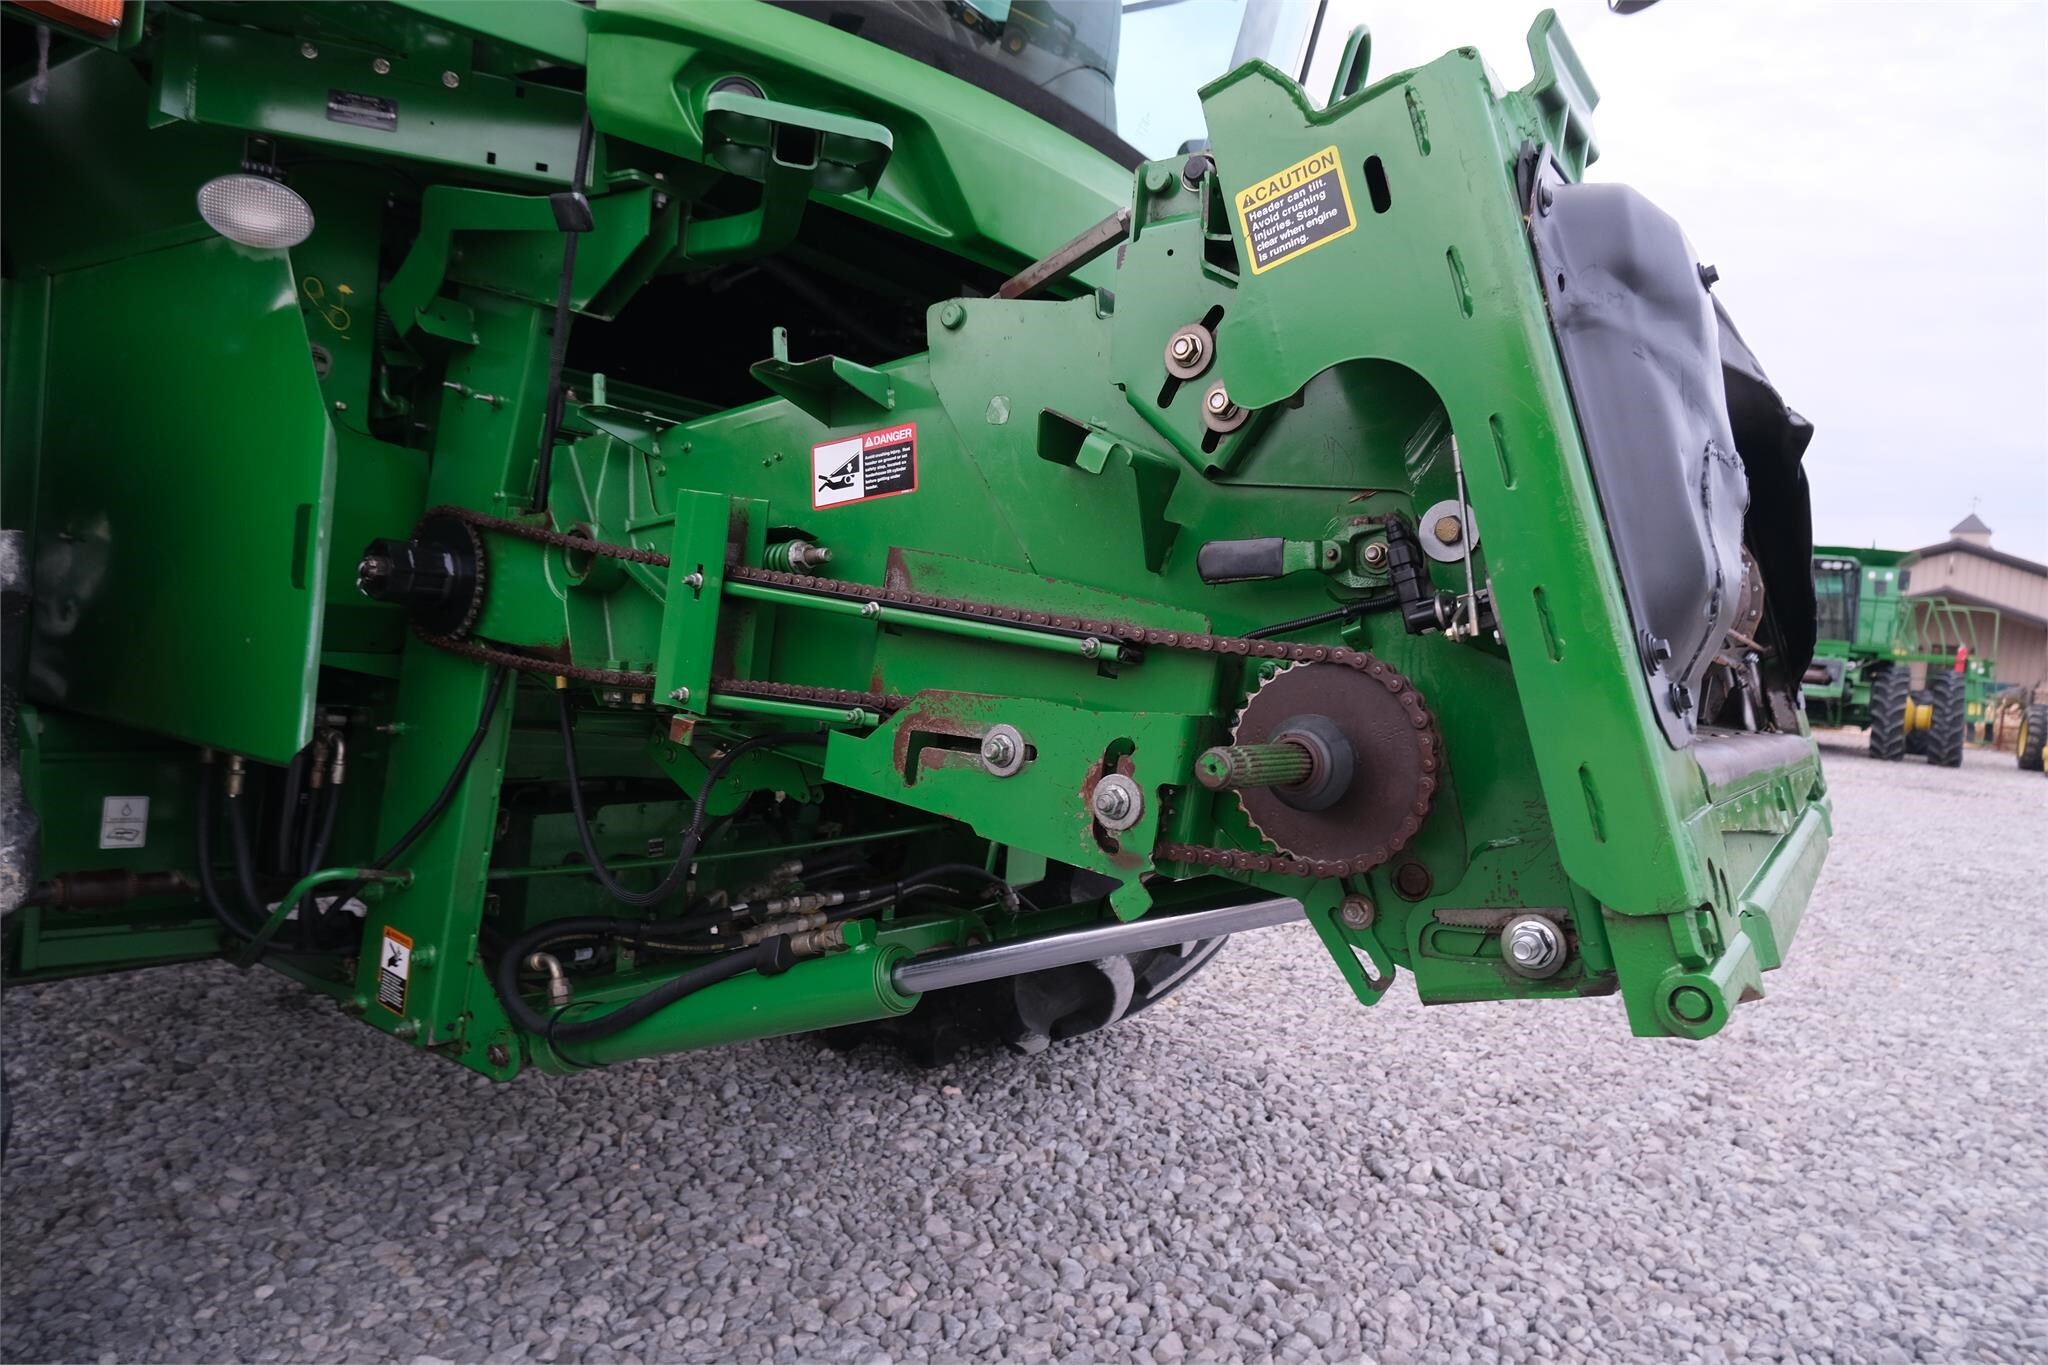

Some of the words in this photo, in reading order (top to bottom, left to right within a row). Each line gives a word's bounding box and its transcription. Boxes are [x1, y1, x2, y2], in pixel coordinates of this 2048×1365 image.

[1256, 152, 1334, 201] CAUTION
[1249, 198, 1284, 222] Header
[1287, 188, 1306, 203] can
[1308, 179, 1326, 195] tilt.
[1252, 212, 1279, 232] Avoid
[1282, 190, 1326, 217] crushing
[1296, 205, 1319, 222] Stay
[1257, 236, 1278, 252] clear
[1280, 224, 1304, 240] when
[1306, 208, 1338, 228] engine
[1270, 235, 1309, 258] running.
[874, 429, 912, 445] DANGER
